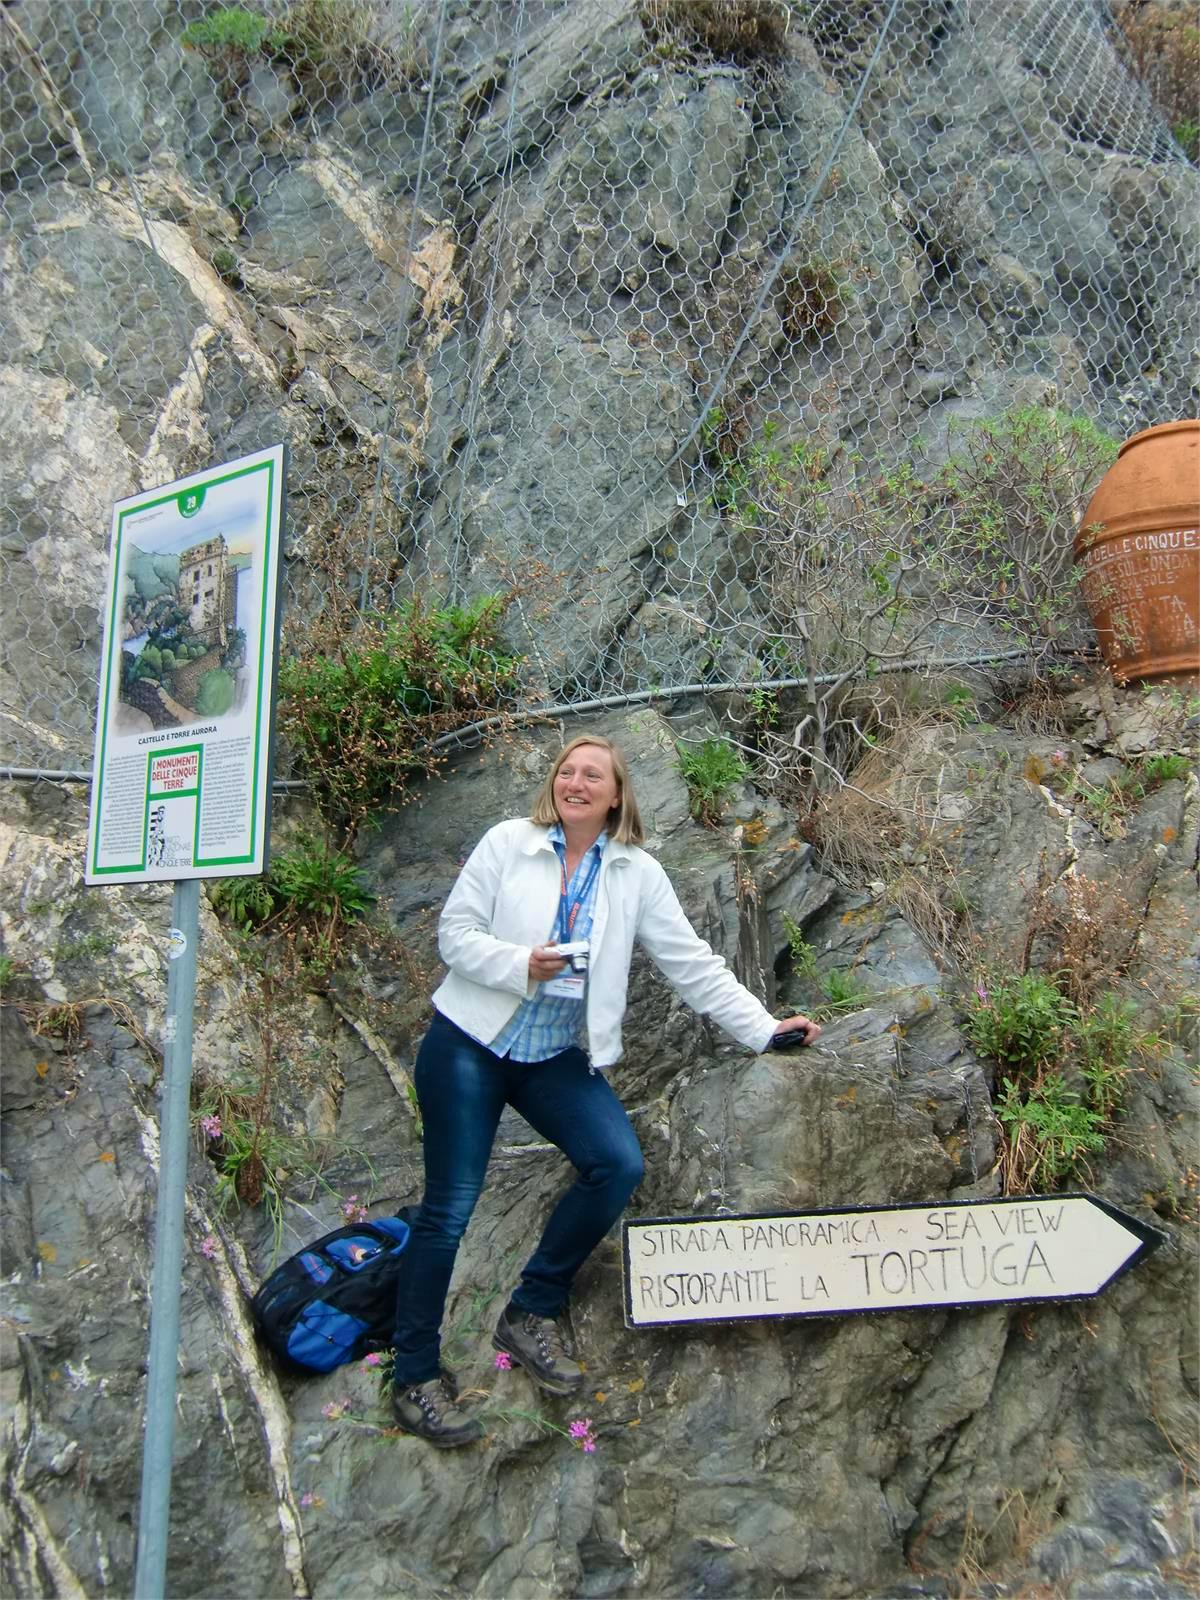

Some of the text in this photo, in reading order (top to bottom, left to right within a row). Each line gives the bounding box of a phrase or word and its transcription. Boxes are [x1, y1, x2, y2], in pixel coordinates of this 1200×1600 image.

[1135, 530, 1196, 551] CINQUE
[137, 734, 165, 745] CASTELLO
[171, 731, 190, 740] TORRE
[191, 725, 218, 736] AURORA
[156, 754, 198, 769] MONUMENTI
[152, 765, 197, 781] DELLE CINQUE
[163, 778, 184, 790] TERRE
[641, 1227, 730, 1257] STRADA
[739, 1219, 880, 1251] PANORAMICA
[926, 1211, 982, 1241] SEA
[991, 1205, 1065, 1236] VIEW
[639, 1240, 1056, 1310] RISTORANTE LA TORTUGA
